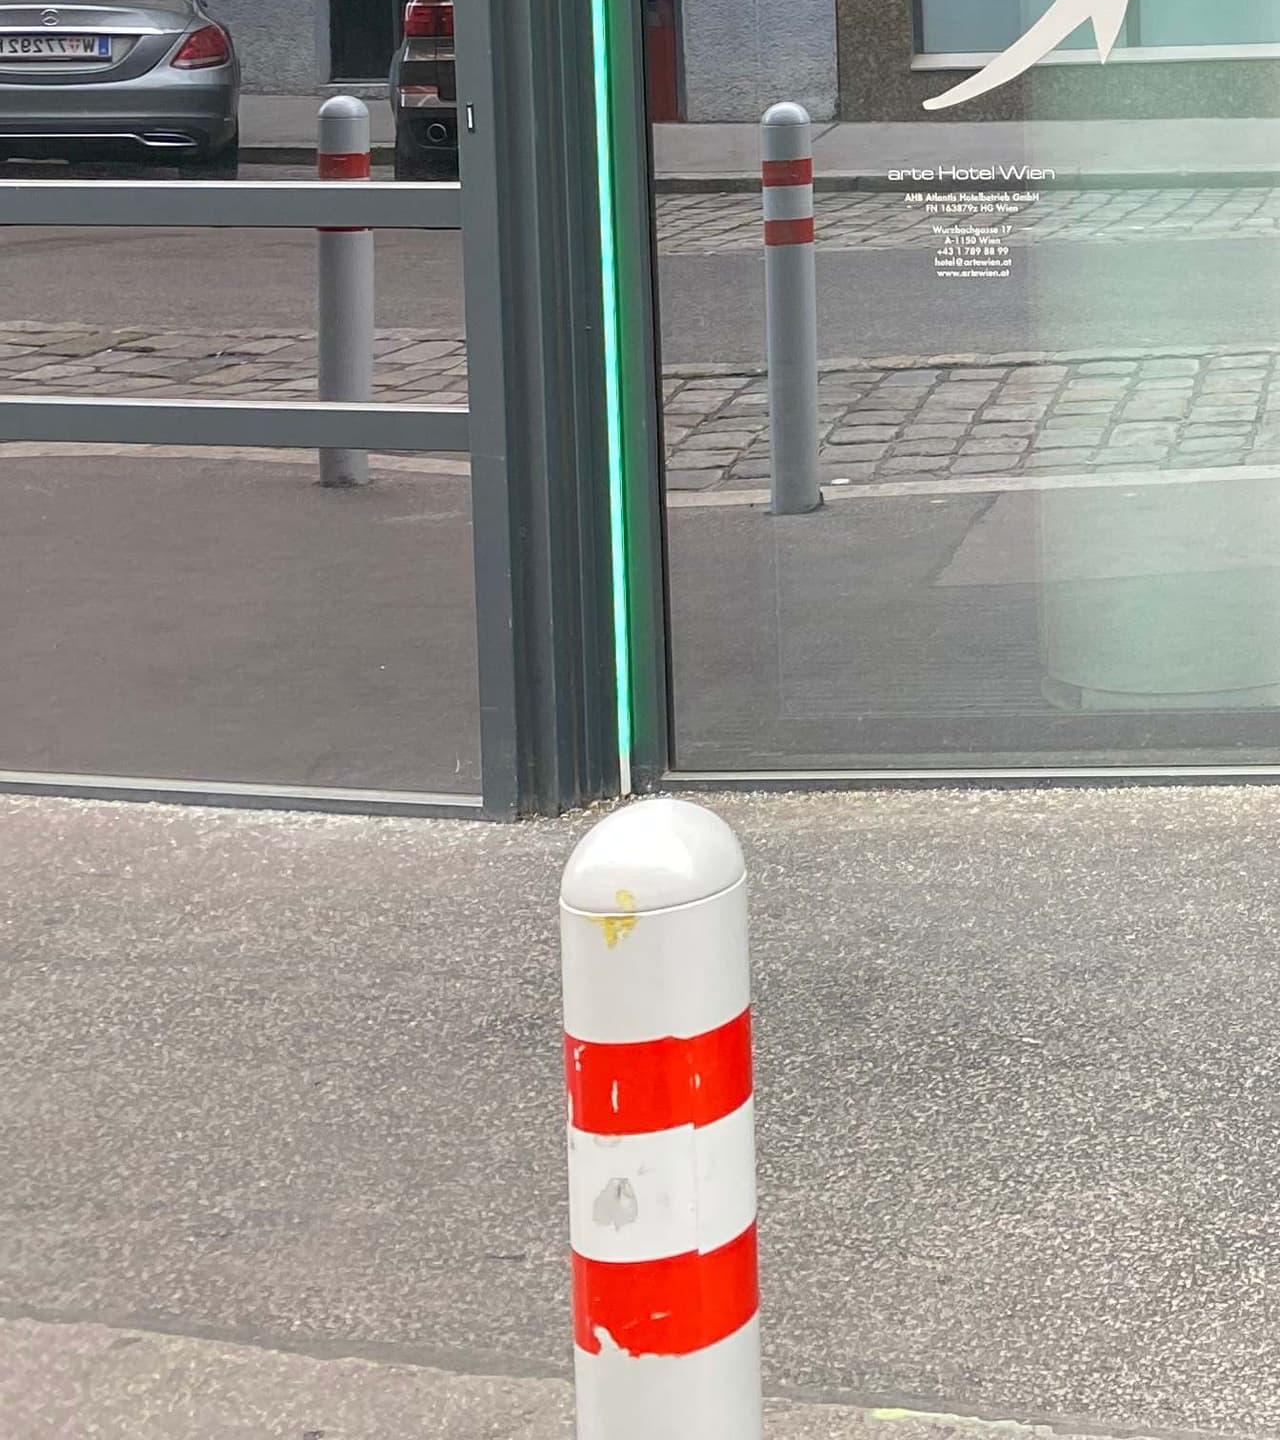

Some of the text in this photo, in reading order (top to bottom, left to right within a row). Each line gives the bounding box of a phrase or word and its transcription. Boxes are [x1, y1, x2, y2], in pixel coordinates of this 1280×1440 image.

[888, 165, 1056, 181] arte Hotel Wien
[1012, 193, 1040, 202] GmbH
[996, 203, 1019, 212] Wien
[1001, 225, 1013, 234] 17
